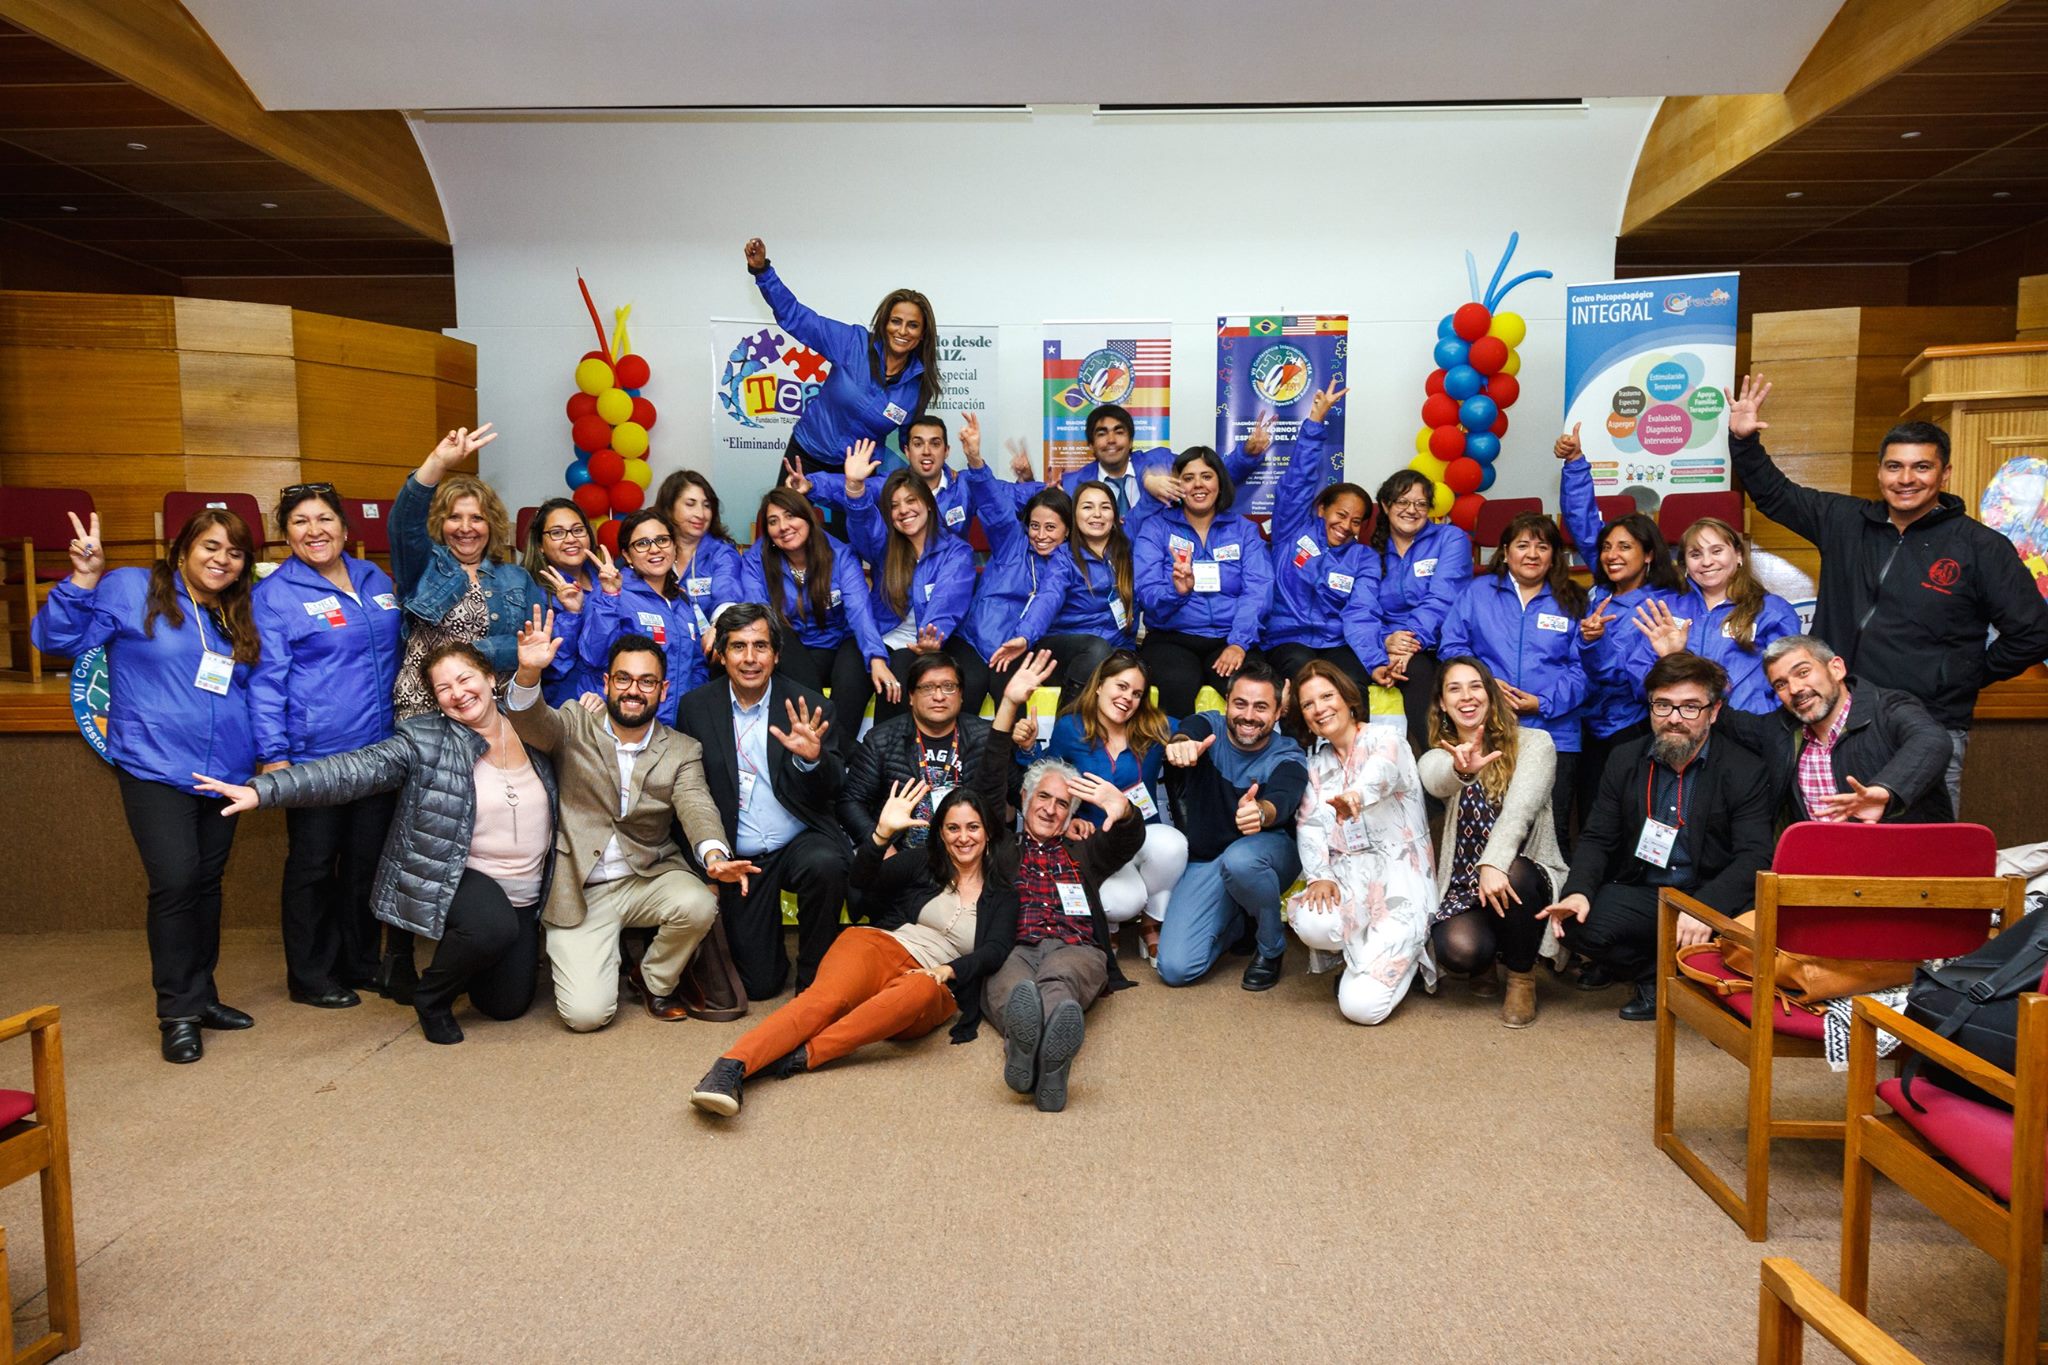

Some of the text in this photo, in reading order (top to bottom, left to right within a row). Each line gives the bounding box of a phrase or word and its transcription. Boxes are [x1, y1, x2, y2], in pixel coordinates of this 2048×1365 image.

[1571, 290, 1654, 304] Centro Psicopedagógico
[1571, 302, 1653, 326] INTEGRAL
[952, 335, 992, 348] desde
[1649, 373, 1686, 381] Estimulación
[942, 386, 970, 395] ornos
[1653, 383, 1682, 391] Temprana
[926, 398, 985, 410] municación
[1647, 414, 1682, 423] Evaluación
[1607, 420, 1635, 429] Asperger
[1645, 425, 1683, 435] Diagnóstico
[1644, 436, 1684, 445] Intervención
[74, 683, 86, 702] VII
